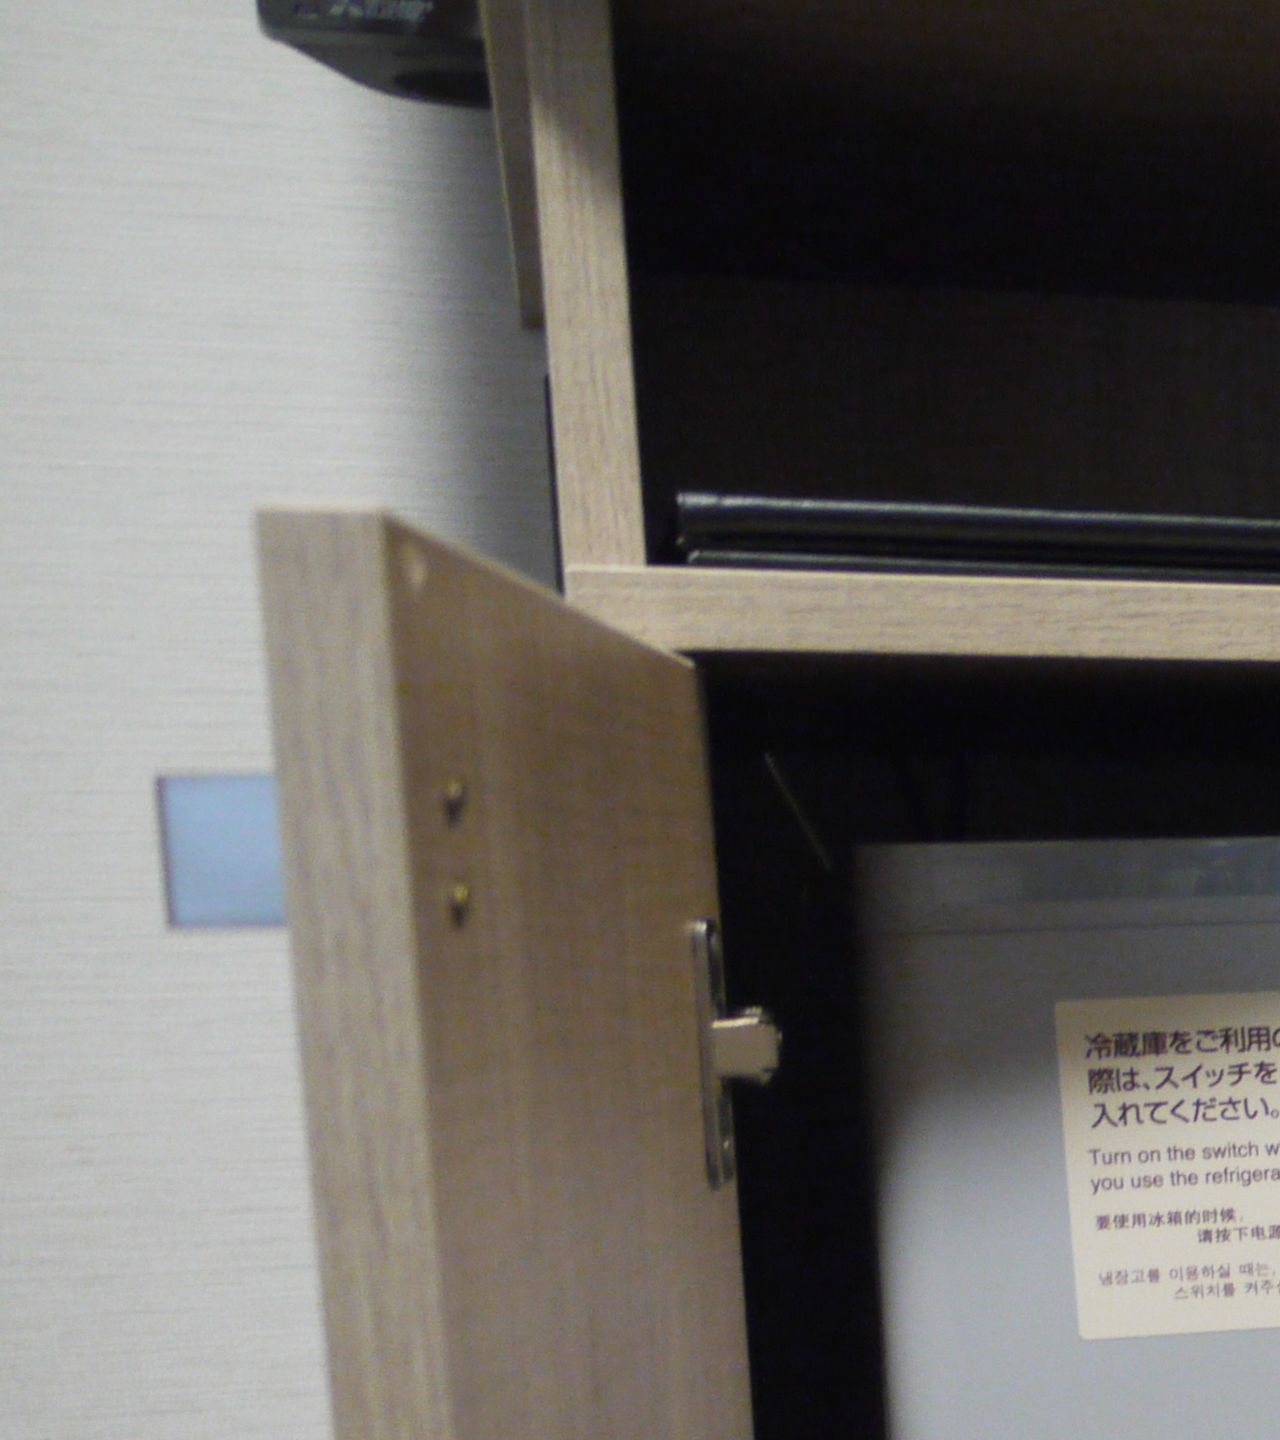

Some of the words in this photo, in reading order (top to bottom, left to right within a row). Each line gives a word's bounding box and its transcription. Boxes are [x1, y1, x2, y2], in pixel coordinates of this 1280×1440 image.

[1087, 1061, 1278, 1095] 際は、スイッチを
[1091, 1097, 1280, 1129] 入れてください。
[1089, 1148, 1132, 1166] Turn
[1137, 1148, 1161, 1163] on
[1167, 1144, 1196, 1162] the
[1202, 1140, 1259, 1160] switch
[1090, 1177, 1125, 1196] you
[1130, 1174, 1164, 1189] use
[1170, 1170, 1199, 1187] the
